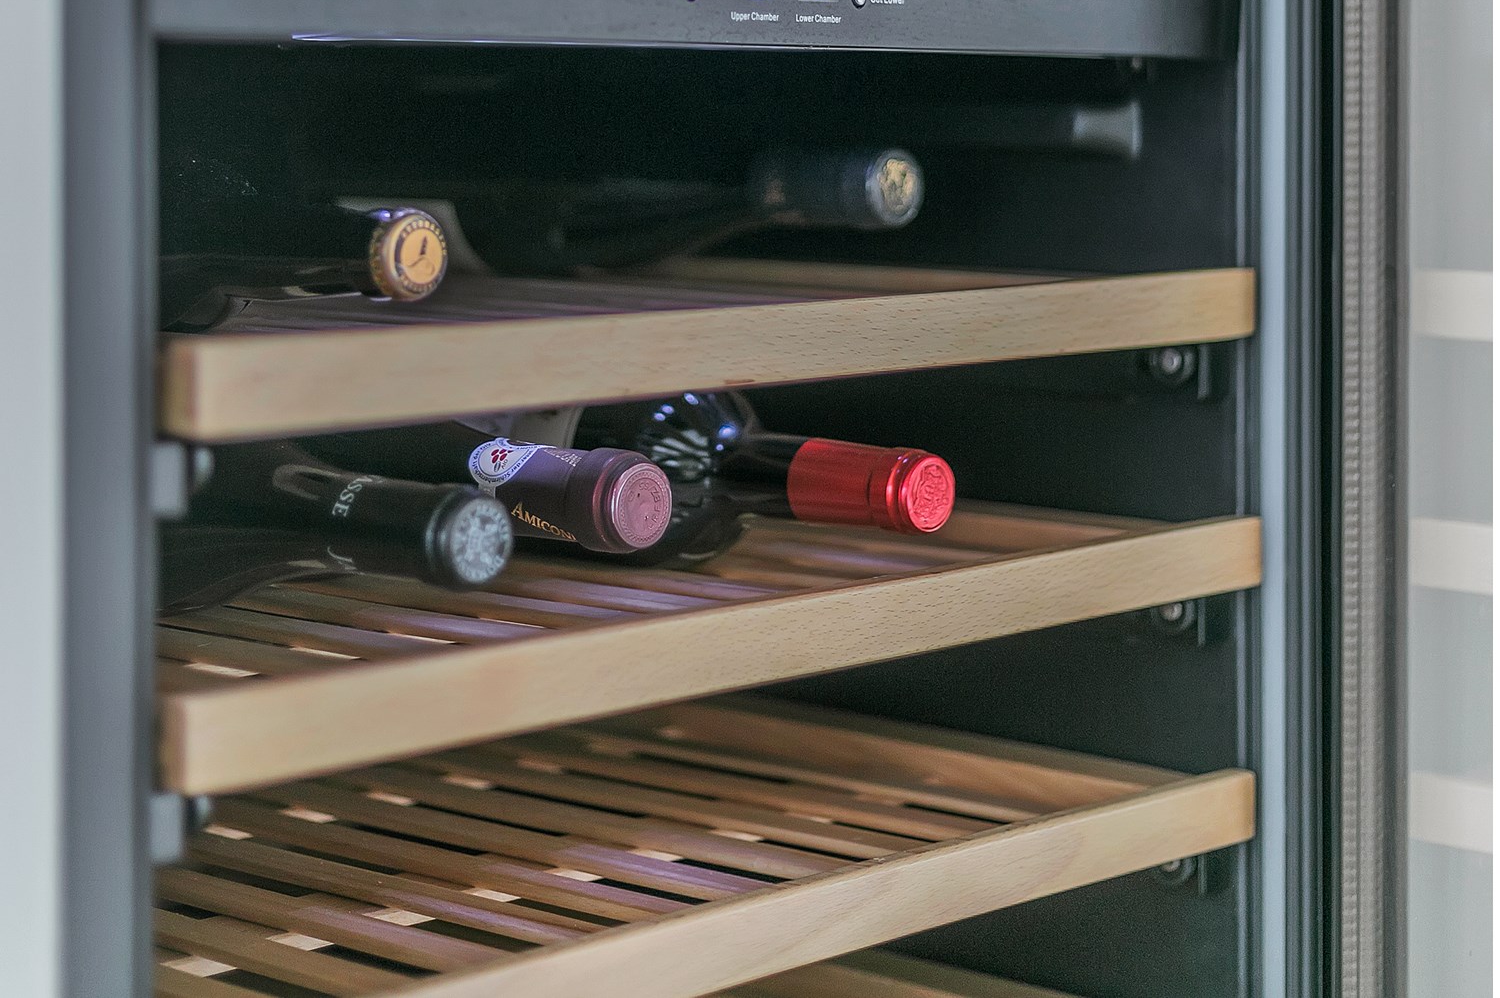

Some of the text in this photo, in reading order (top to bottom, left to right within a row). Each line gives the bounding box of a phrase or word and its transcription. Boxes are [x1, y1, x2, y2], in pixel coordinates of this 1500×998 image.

[730, 11, 780, 22] Upper Chamber
[795, 14, 842, 24] Lower Chamber
